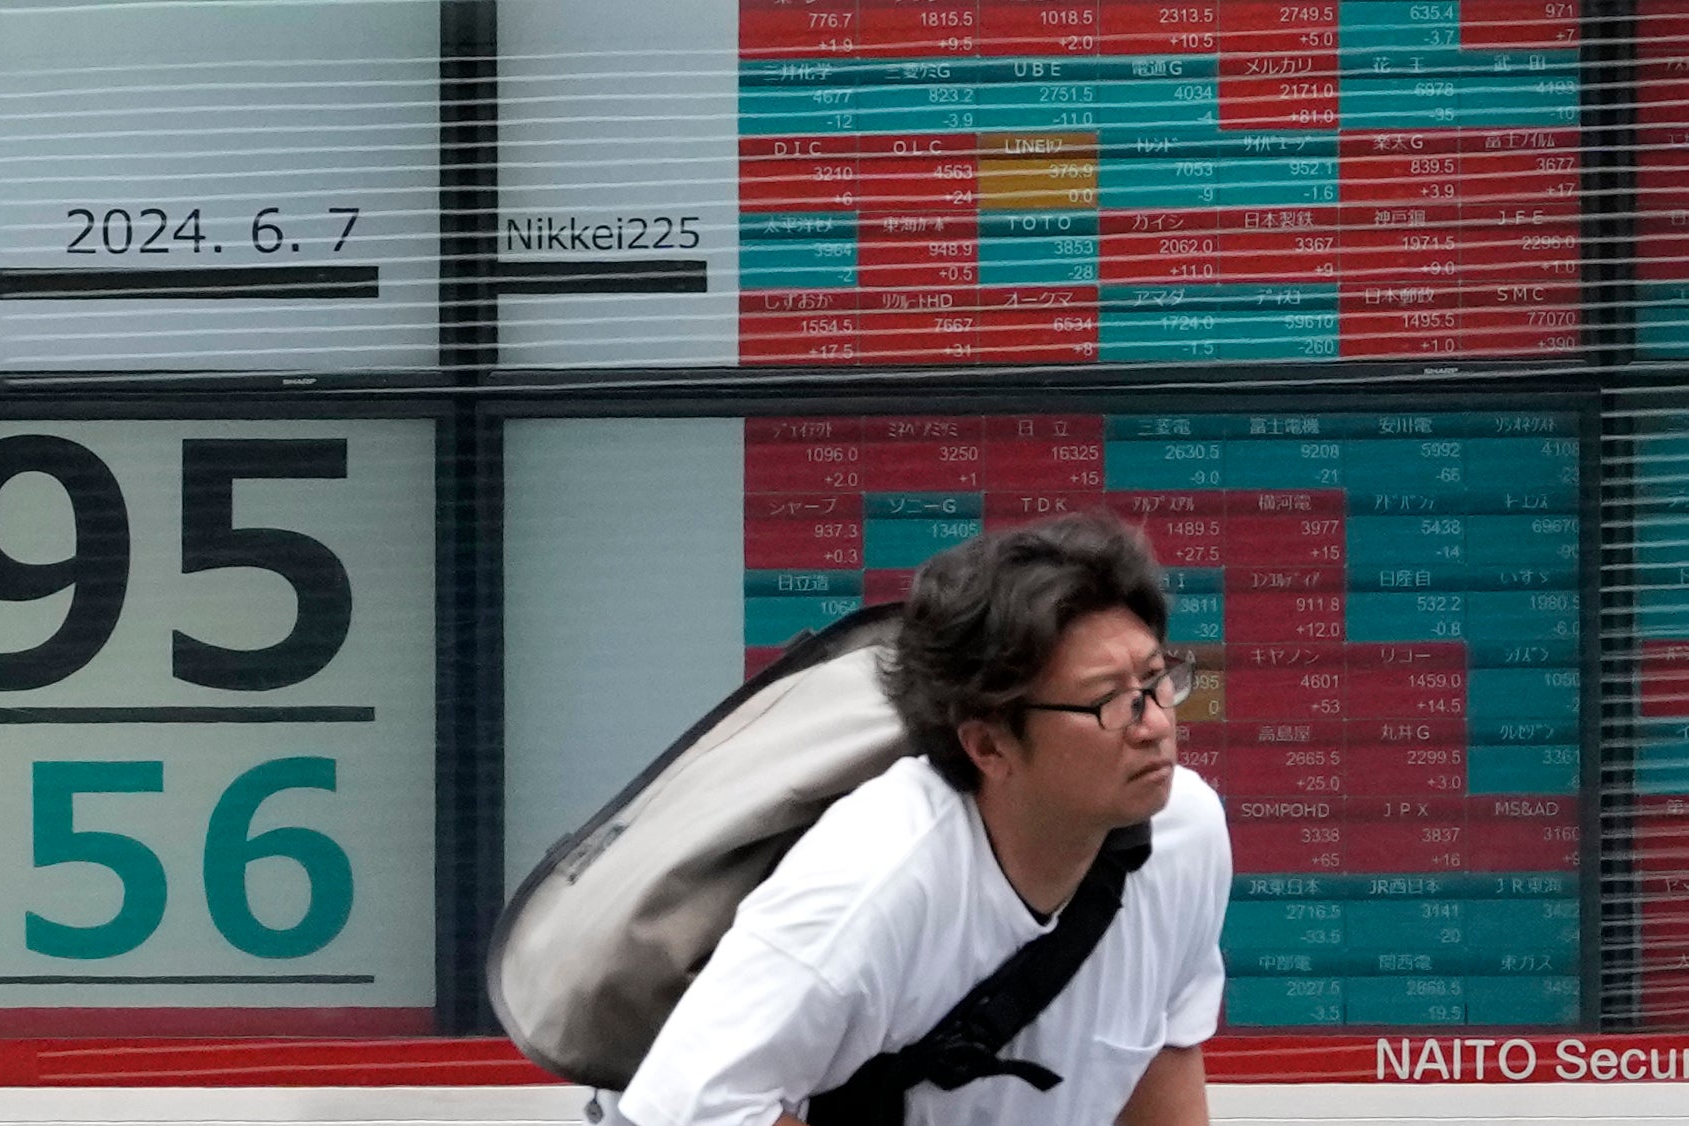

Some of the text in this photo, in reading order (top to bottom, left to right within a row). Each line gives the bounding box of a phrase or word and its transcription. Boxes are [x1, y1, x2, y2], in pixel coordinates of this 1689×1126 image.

[1040, 10, 1093, 25] 1018.5
[1159, 8, 1214, 23] 2313.5
[1279, 7, 1333, 23] 2749.5
[1409, 5, 1454, 21] 635.4
[1545, 3, 1575, 18] 971
[808, 12, 852, 28] 776.7
[920, 11, 973, 27] 1815.5
[938, 36, 973, 51] +9.5
[1058, 35, 1094, 51] +2.0
[1169, 33, 1214, 49] +10.5
[1298, 31, 1333, 47] +5.0
[1423, 29, 1455, 46] -3.7
[1244, 57, 1313, 75] メルカリ
[928, 88, 974, 103] 823.2
[1039, 86, 1093, 103] 2751.5
[1173, 85, 1213, 101] 4034
[1279, 83, 1335, 100] 2171.0
[826, 114, 853, 129] -12
[942, 112, 974, 128] -3.9
[1290, 160, 1333, 176] 952.1
[1409, 158, 1455, 174] 839.5
[1535, 157, 1576, 173] 3677
[1303, 185, 1334, 201] -1.6
[1420, 183, 1455, 199] +3.9
[329, 208, 359, 252] 7
[508, 216, 700, 250] Nikkei225
[928, 242, 973, 257] 948.9
[1053, 240, 1094, 256] 3853
[1159, 239, 1214, 255] 2062.0
[1294, 236, 1335, 253] 3367
[1401, 235, 1455, 251] 1971.5
[838, 268, 853, 283] -2
[938, 266, 973, 282] +0.5
[1067, 265, 1094, 281] -28
[1169, 263, 1213, 279] +11.0
[800, 319, 853, 334] 1554.5
[934, 318, 973, 333] 7667
[1401, 313, 1455, 329] 1495.5
[1526, 311, 1576, 327] 77070
[1420, 337, 1455, 353] +1.0
[938, 446, 979, 462] 3250
[1050, 445, 1099, 461] 16325
[823, 472, 859, 487] +2.0
[1070, 471, 1099, 486] +15
[814, 524, 859, 539] 937.3
[1167, 521, 1220, 536] 1489.5
[1300, 520, 1340, 535] 3977
[823, 549, 859, 563] +0.3
[1310, 545, 1340, 560] +15
[1296, 597, 1340, 612] 911.8
[1295, 622, 1341, 637] +12.0
[1300, 674, 1340, 689] 4601
[1407, 673, 1461, 689] 1459.0
[1416, 698, 1461, 713] +14.5
[1406, 750, 1461, 766] 2299.5
[1240, 803, 1330, 818] SOMPOHD
[1375, 1037, 1537, 1081] NAITO
